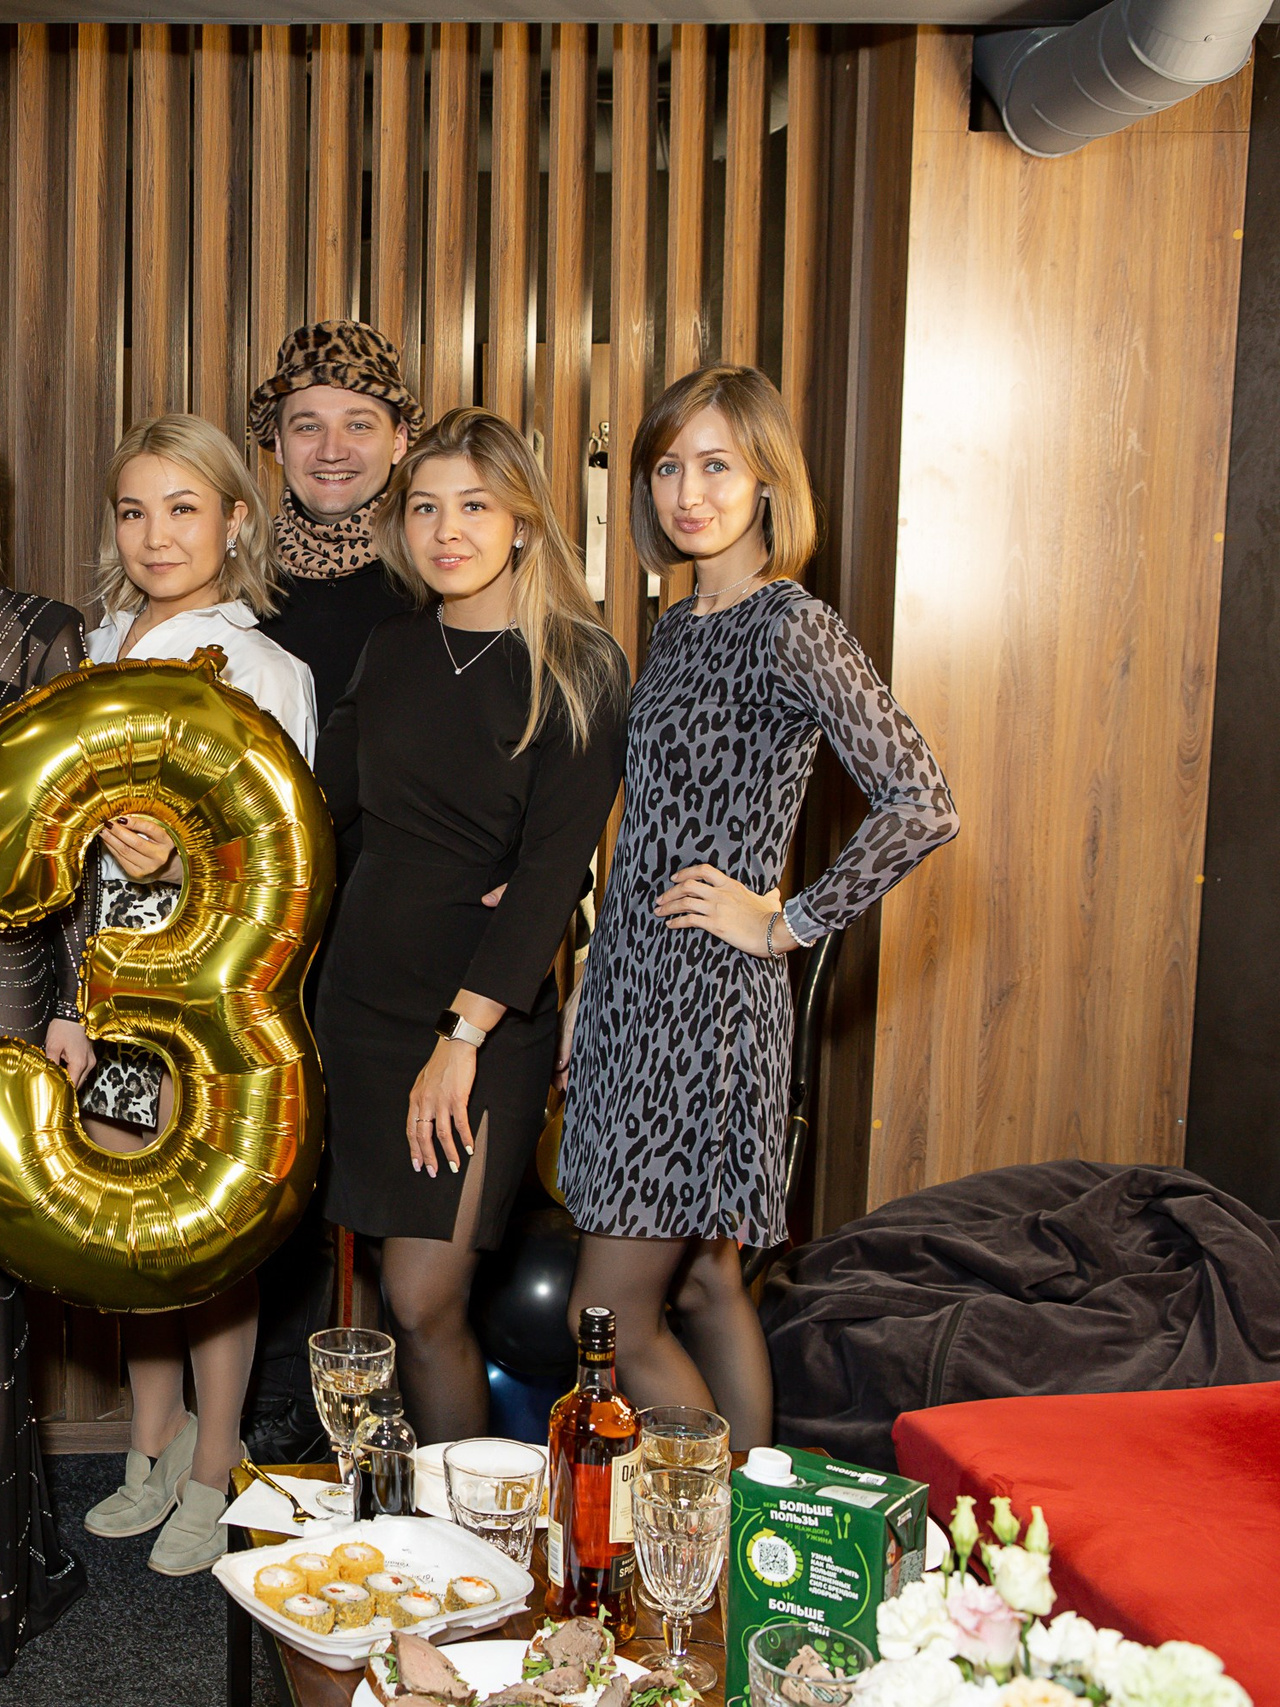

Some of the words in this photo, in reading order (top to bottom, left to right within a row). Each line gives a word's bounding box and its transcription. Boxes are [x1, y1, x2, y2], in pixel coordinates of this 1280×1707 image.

[778, 1499, 834, 1518] БОЛЬШЕ
[769, 1509, 819, 1527] ПОЛЬЗЫ
[805, 1533, 833, 1546] УЖИНА
[768, 1597, 826, 1622] БОЛЬШЕ
[807, 1621, 831, 1637] СИЛ
